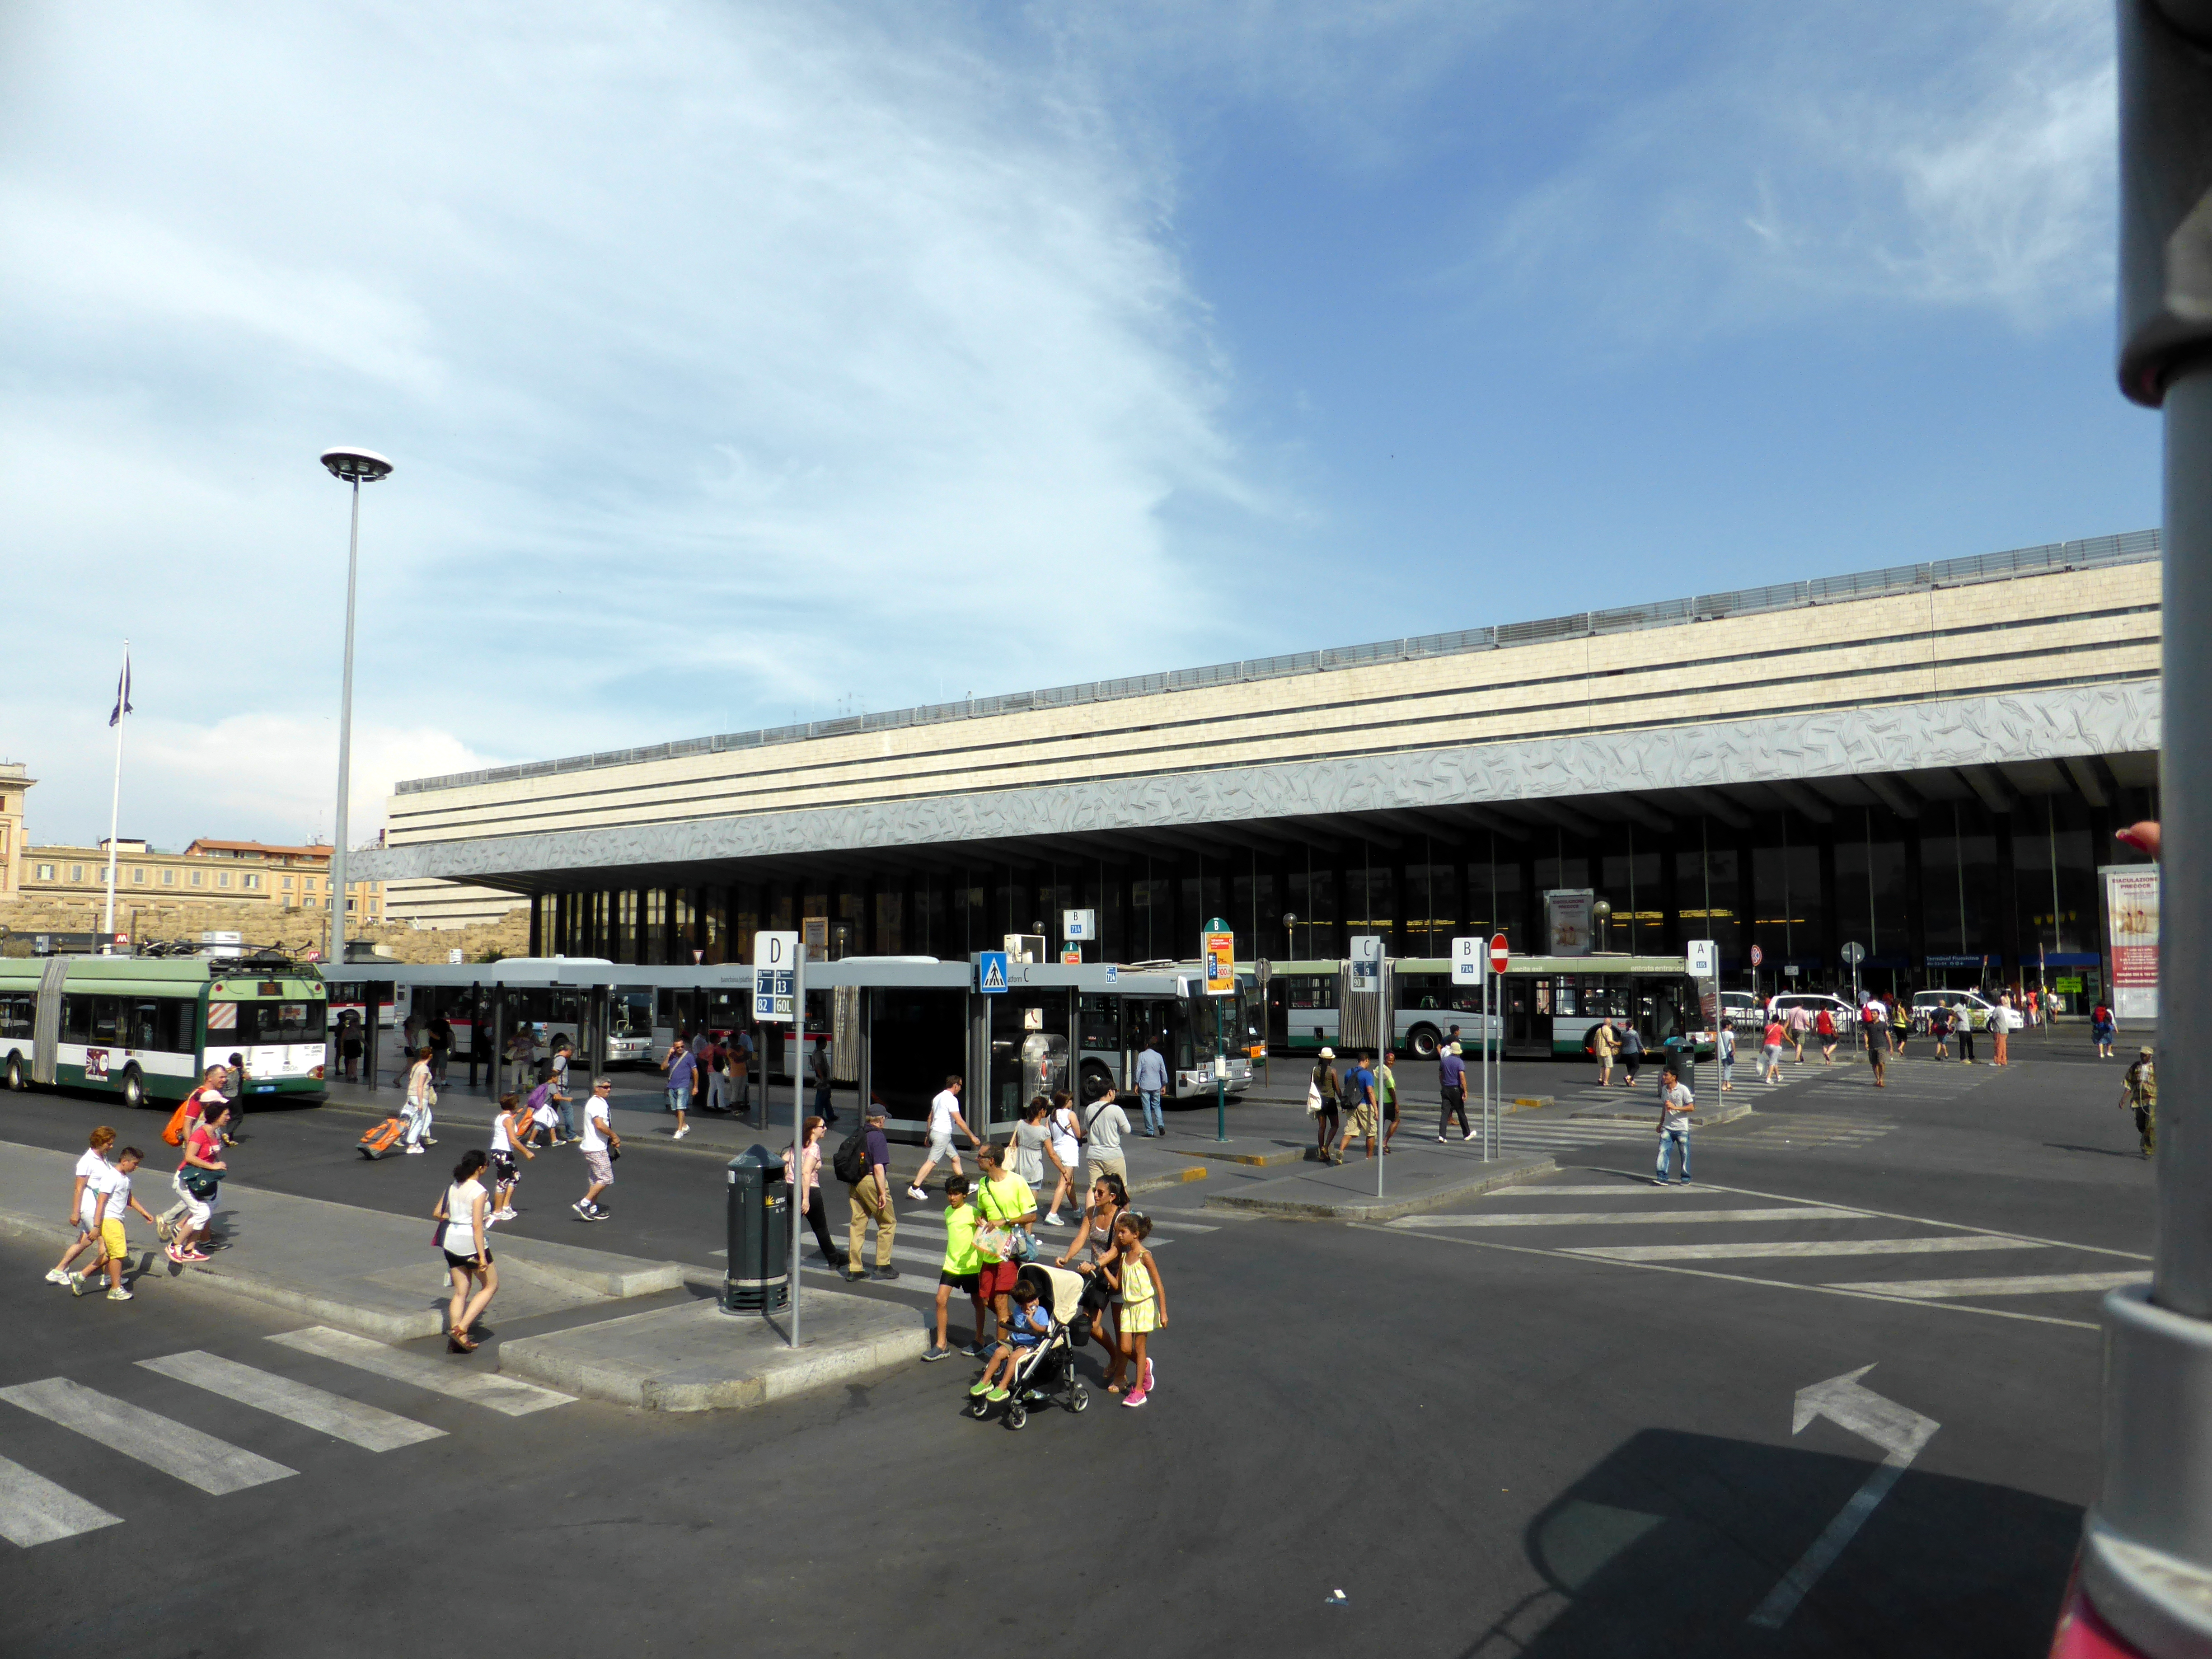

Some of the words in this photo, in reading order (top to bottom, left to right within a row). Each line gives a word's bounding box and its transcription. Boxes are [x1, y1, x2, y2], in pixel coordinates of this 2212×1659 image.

[1073, 911, 1078, 921] B
[1214, 920, 1219, 931] B
[771, 938, 781, 963] D
[1364, 940, 1370, 956] C
[1464, 941, 1471, 955] B
[1697, 943, 1704, 954] A
[1024, 967, 1029, 982] C
[1107, 973, 1115, 981] 714
[1366, 967, 1370, 975] 9
[758, 980, 764, 992] 7
[777, 980, 787, 993] 13
[1354, 979, 1361, 987] 90
[758, 998, 768, 1011] 82
[777, 999, 792, 1012] 60L
